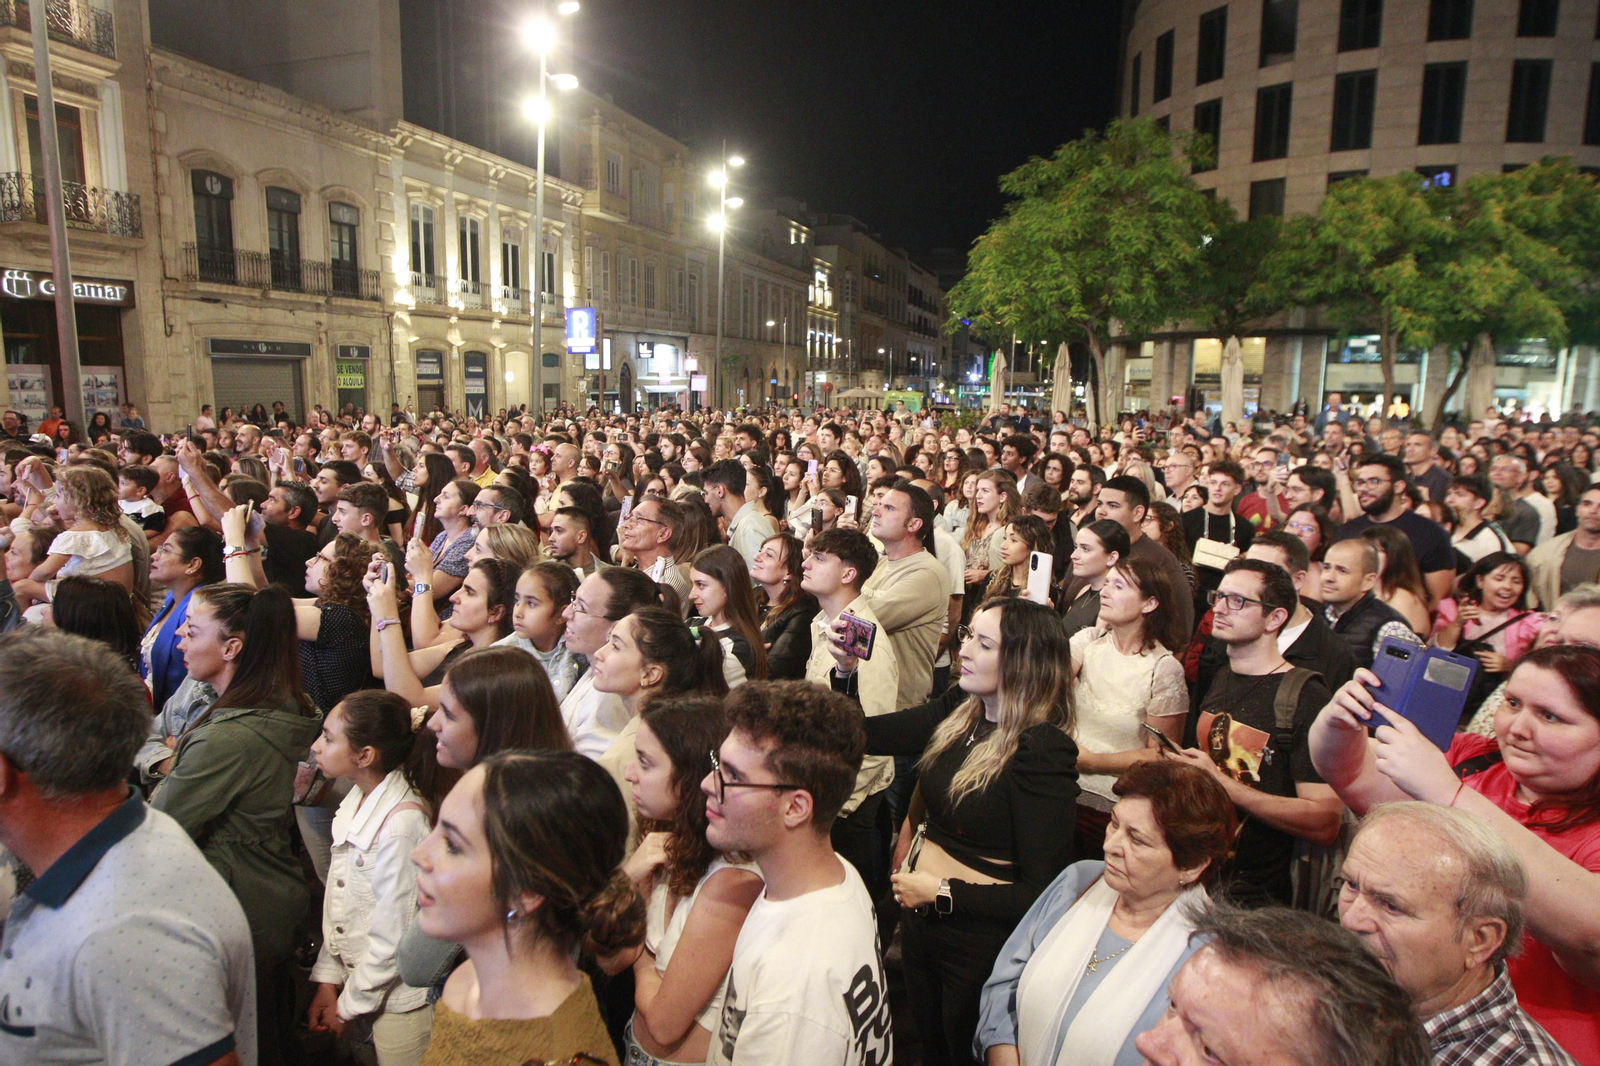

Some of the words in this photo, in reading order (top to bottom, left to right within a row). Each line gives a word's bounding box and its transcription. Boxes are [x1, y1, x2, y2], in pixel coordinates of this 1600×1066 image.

[39, 279, 127, 301] Camar
[336, 364, 344, 374] SE
[344, 364, 362, 374] VENDE
[338, 378, 342, 386] O
[342, 378, 363, 386] ALQUILA
